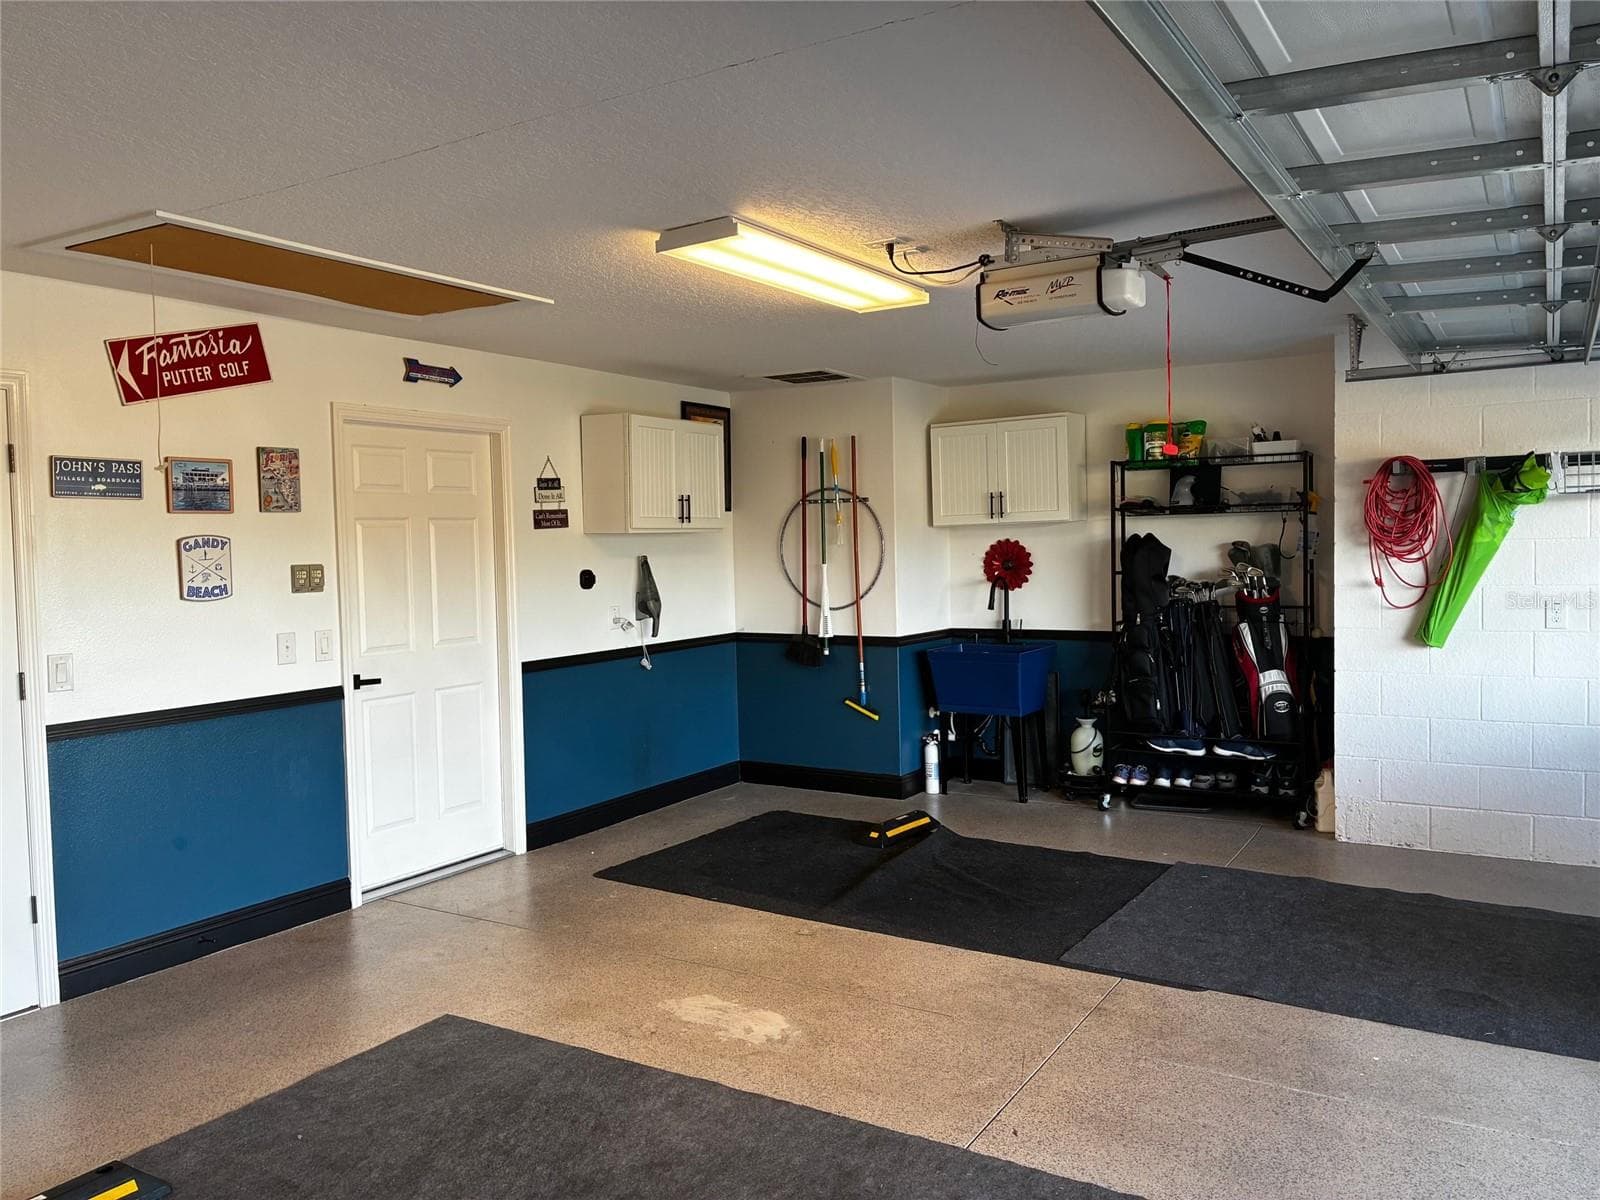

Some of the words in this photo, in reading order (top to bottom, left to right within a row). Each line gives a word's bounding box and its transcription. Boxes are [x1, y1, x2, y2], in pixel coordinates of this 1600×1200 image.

[135, 330, 252, 375] Fantasia
[162, 366, 213, 387] PUTTER
[219, 361, 249, 378] GOLF
[56, 461, 105, 474] JOHN'S
[112, 463, 141, 474] PASS
[183, 537, 228, 553] GANDY
[187, 584, 228, 598] BEACH
